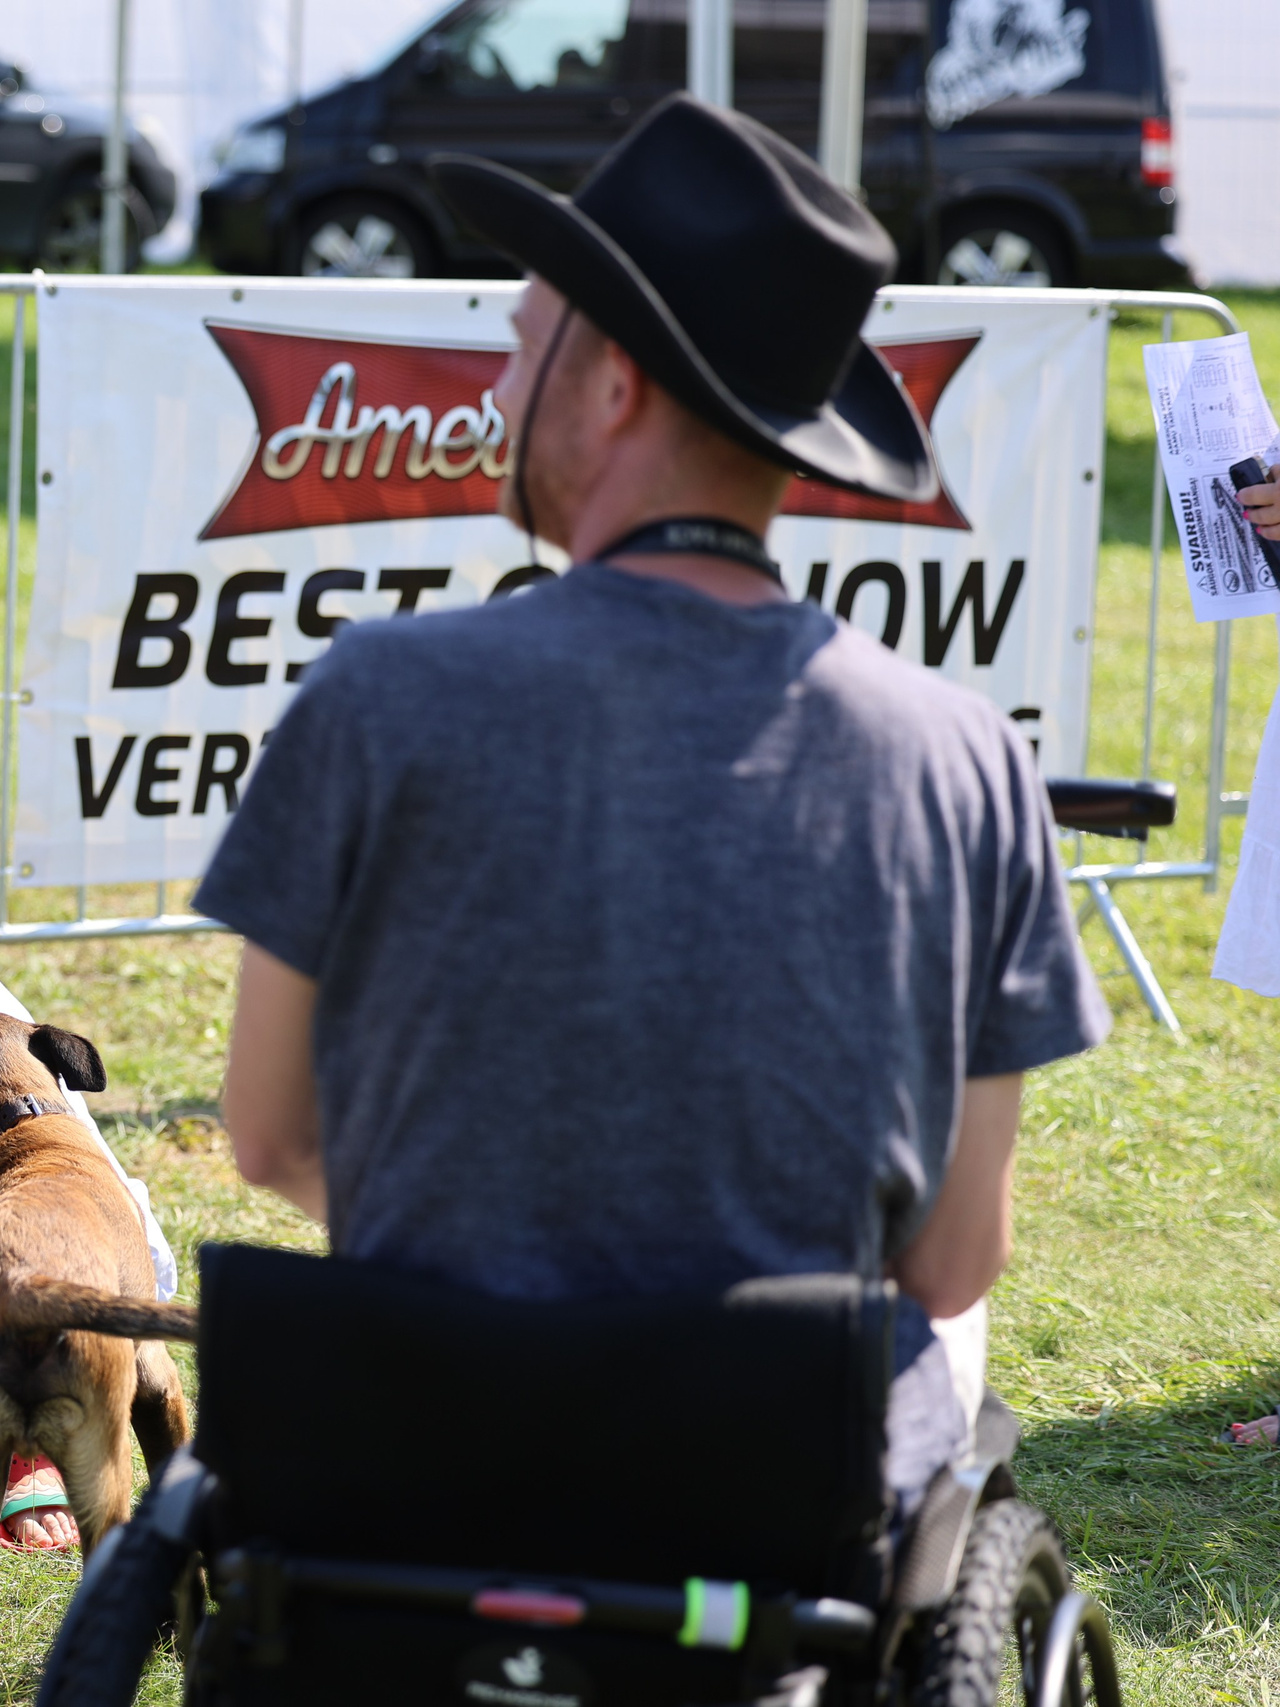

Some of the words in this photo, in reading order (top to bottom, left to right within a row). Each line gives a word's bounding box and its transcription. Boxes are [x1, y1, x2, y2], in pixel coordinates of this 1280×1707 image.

[261, 361, 517, 479] Amer
[1179, 492, 1204, 573] SVARBU!
[1195, 509, 1211, 560] AERODROMO
[808, 560, 1025, 667] OW
[1205, 562, 1218, 596] SAUGOK
[75, 733, 271, 819] VER
